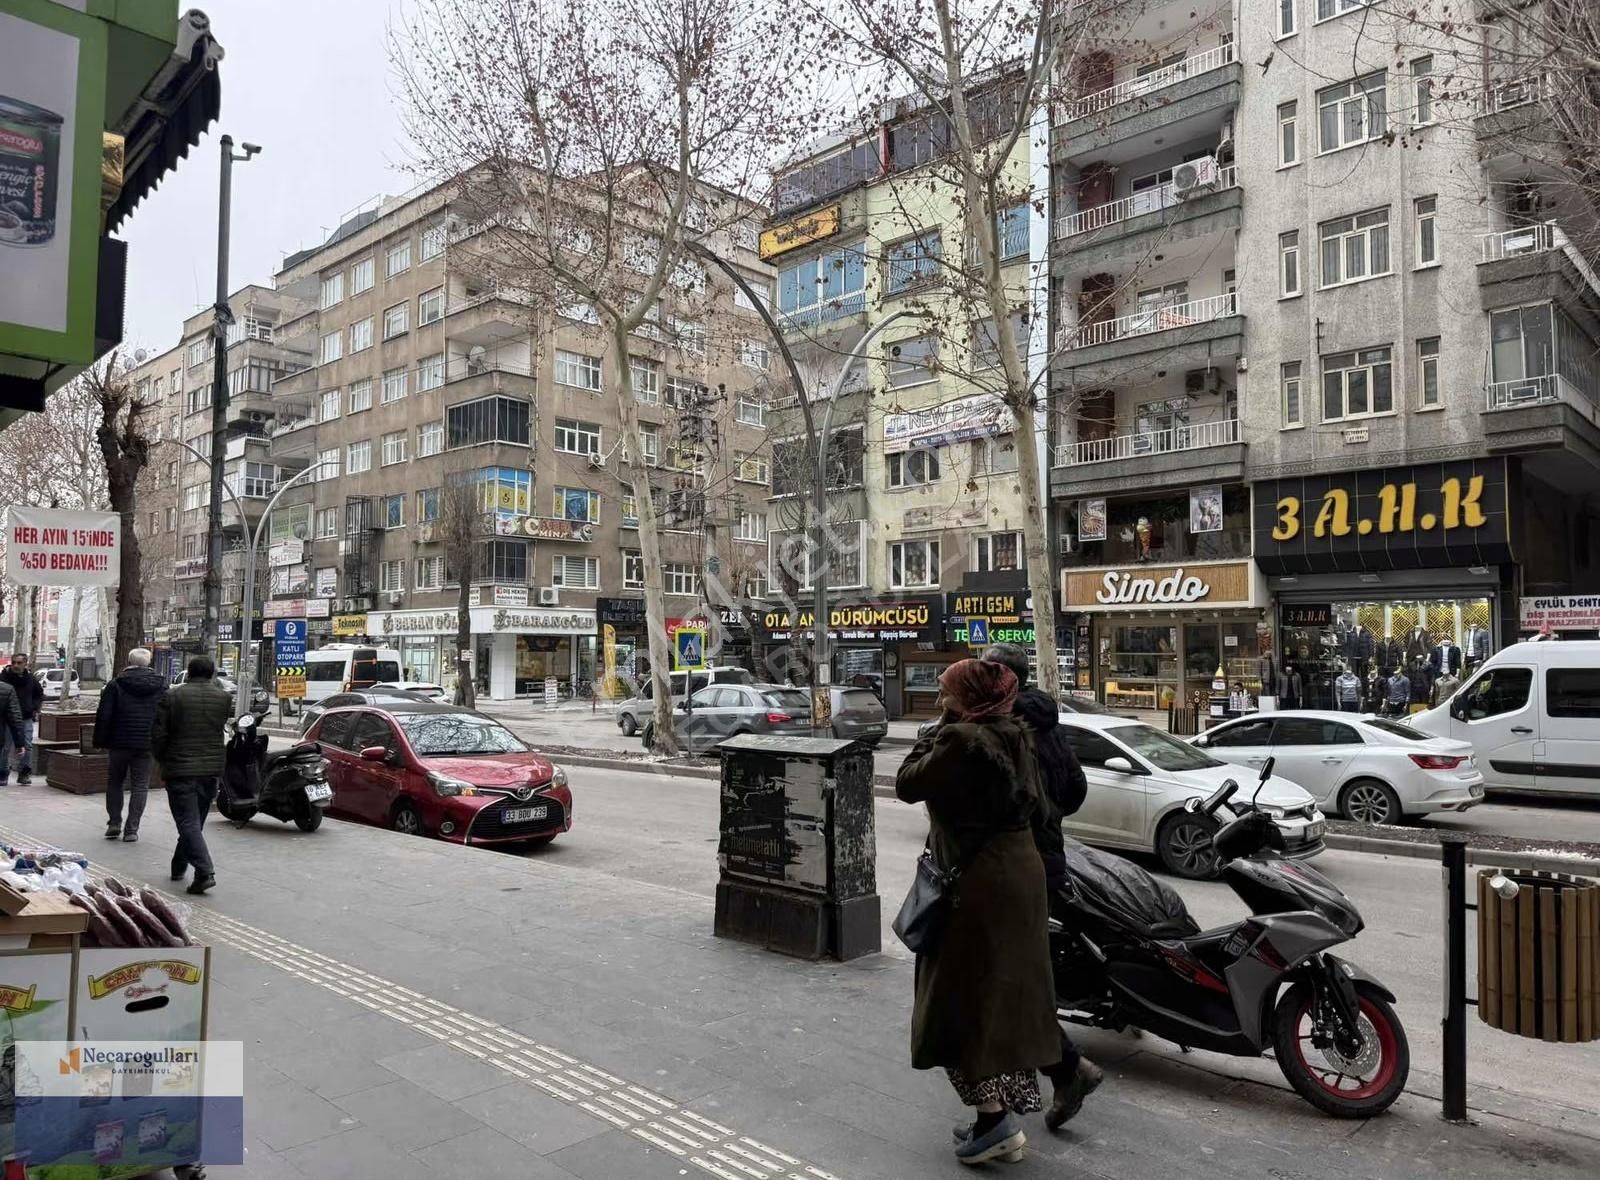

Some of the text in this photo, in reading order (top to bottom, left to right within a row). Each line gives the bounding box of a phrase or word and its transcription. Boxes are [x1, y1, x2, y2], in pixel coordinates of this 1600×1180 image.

[909, 405, 949, 430] NEW
[1272, 475, 1488, 541] 3 A.H.K
[14, 527, 38, 545] HER
[41, 527, 68, 546] AYIN
[20, 551, 108, 571] %50 BEDAVA!!!
[1096, 568, 1210, 604] Simdo
[986, 596, 1014, 613] GSM
[1535, 596, 1566, 609] EYLÜL
[765, 613, 779, 628] 01
[831, 605, 929, 627] DÜRÜMCÜSÜ
[276, 653, 304, 661] OTOPARK
[505, 810, 516, 820] 33
